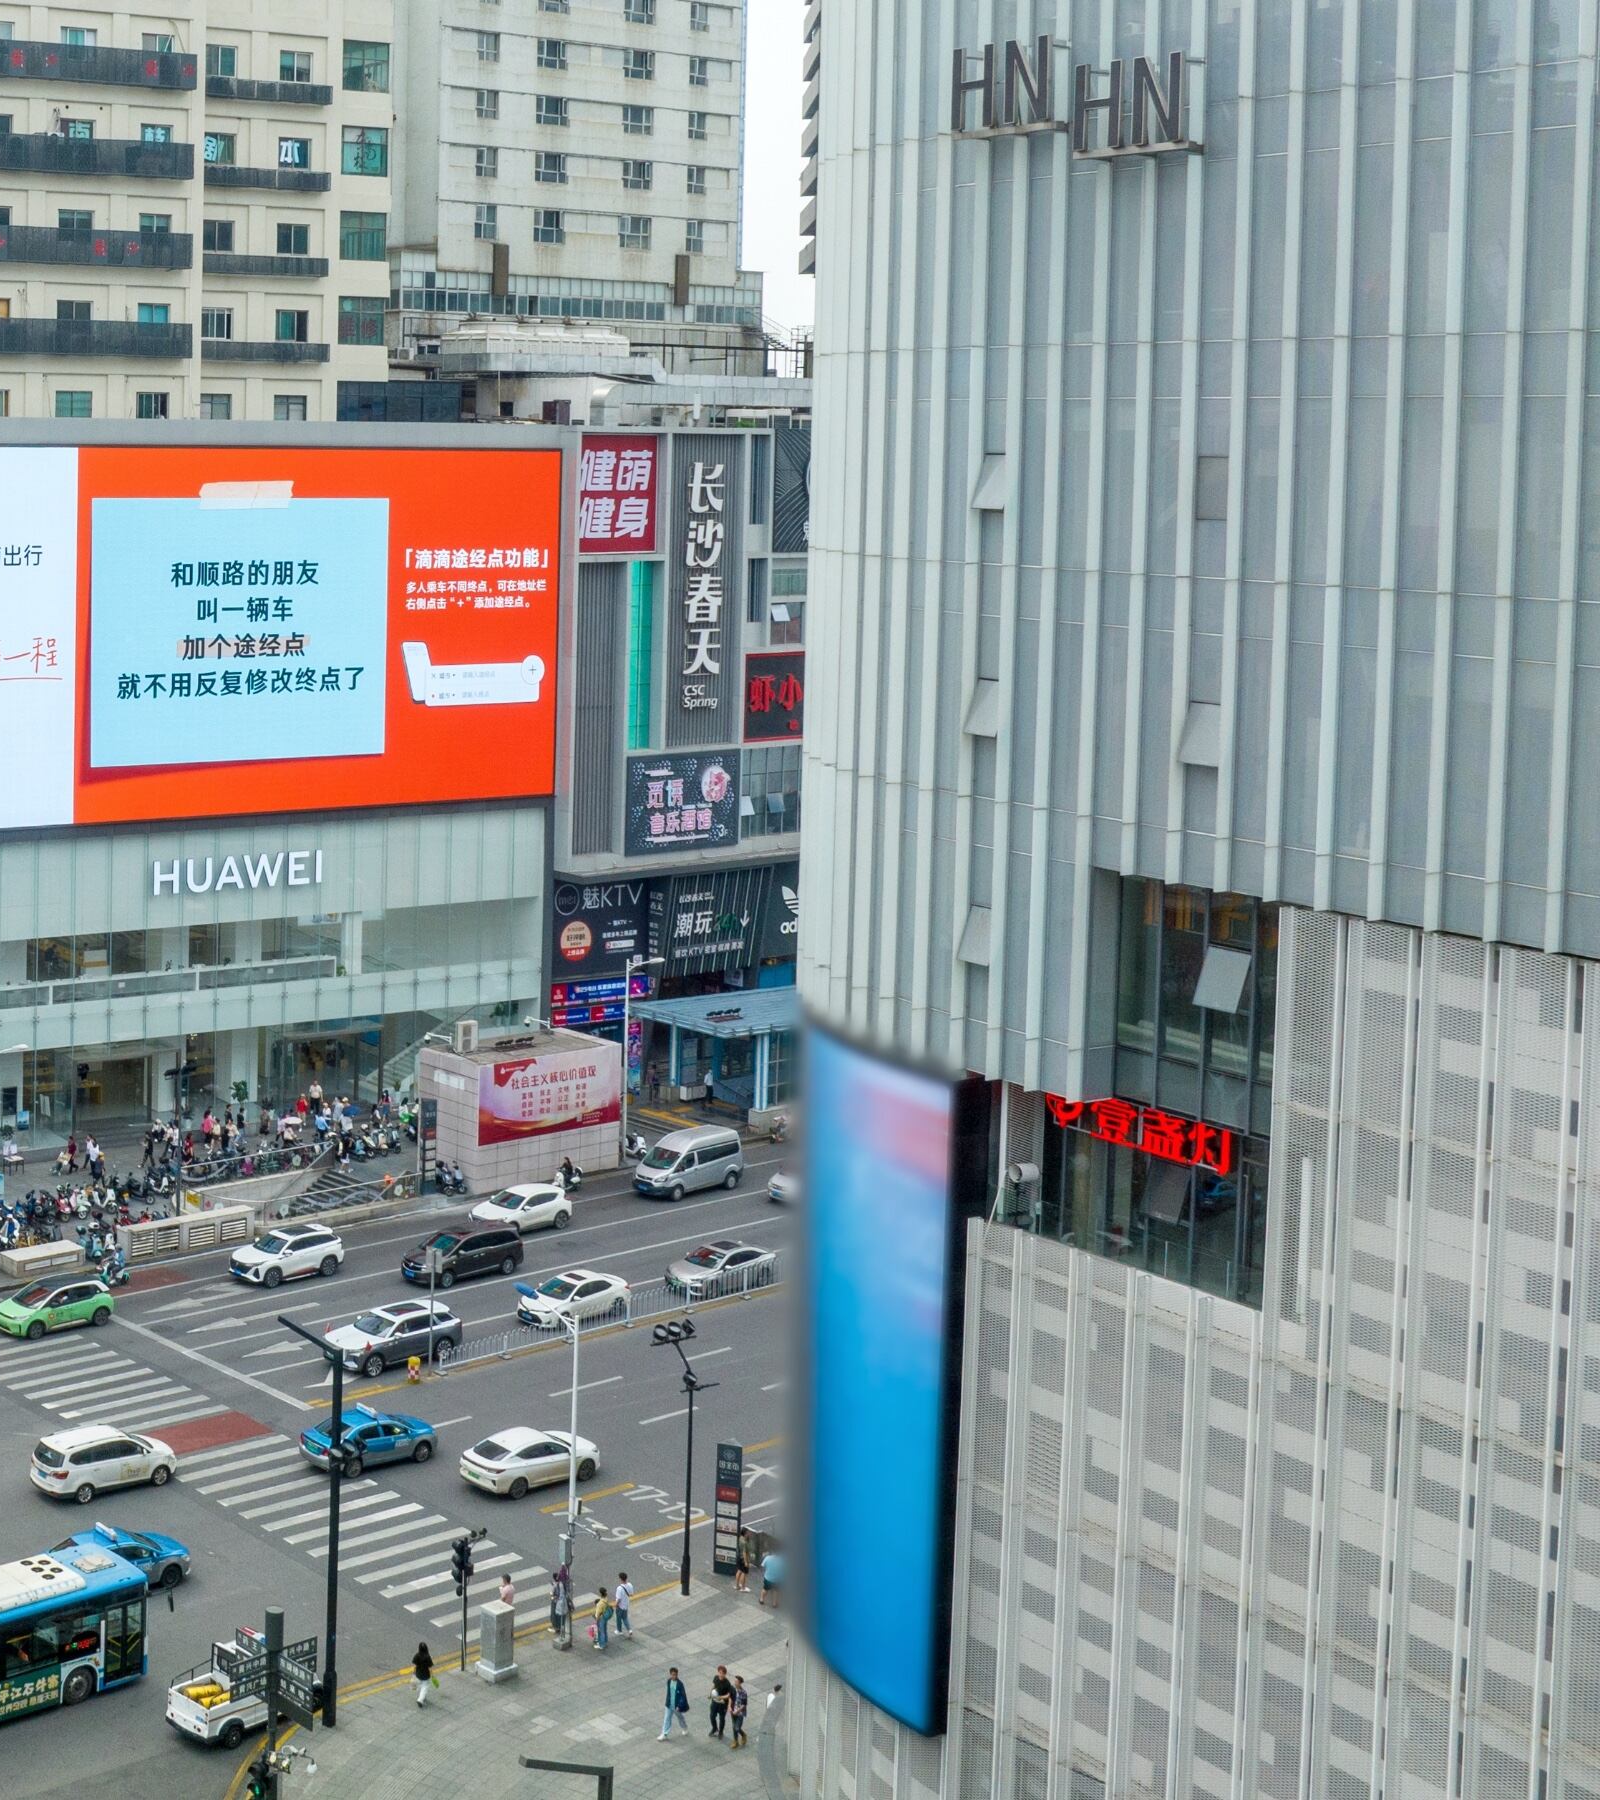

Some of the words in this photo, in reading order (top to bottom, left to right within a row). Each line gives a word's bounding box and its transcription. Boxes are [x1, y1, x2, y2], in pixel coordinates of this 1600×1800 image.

[952, 34, 1052, 131] HN
[1073, 51, 1186, 151] HN
[580, 450, 653, 491] 健萌
[579, 496, 649, 538] 健身
[405, 548, 548, 569] 「滴滴途经点功能」
[683, 461, 725, 675] 长沙春天
[171, 559, 319, 588] 和顺路的朋友
[197, 596, 293, 623] 叫一辆车
[182, 632, 305, 661] 加个途经点
[117, 666, 365, 700] 就不用反复修改终点了
[684, 685, 705, 696] CSC
[683, 696, 718, 710] Spring
[650, 808, 712, 834] 音乐酒馆
[153, 849, 322, 896] HUAWEI
[582, 883, 643, 910] 魅KTV
[689, 946, 703, 956] KTV
[511, 1065, 597, 1090] 社会主义核心价值观
